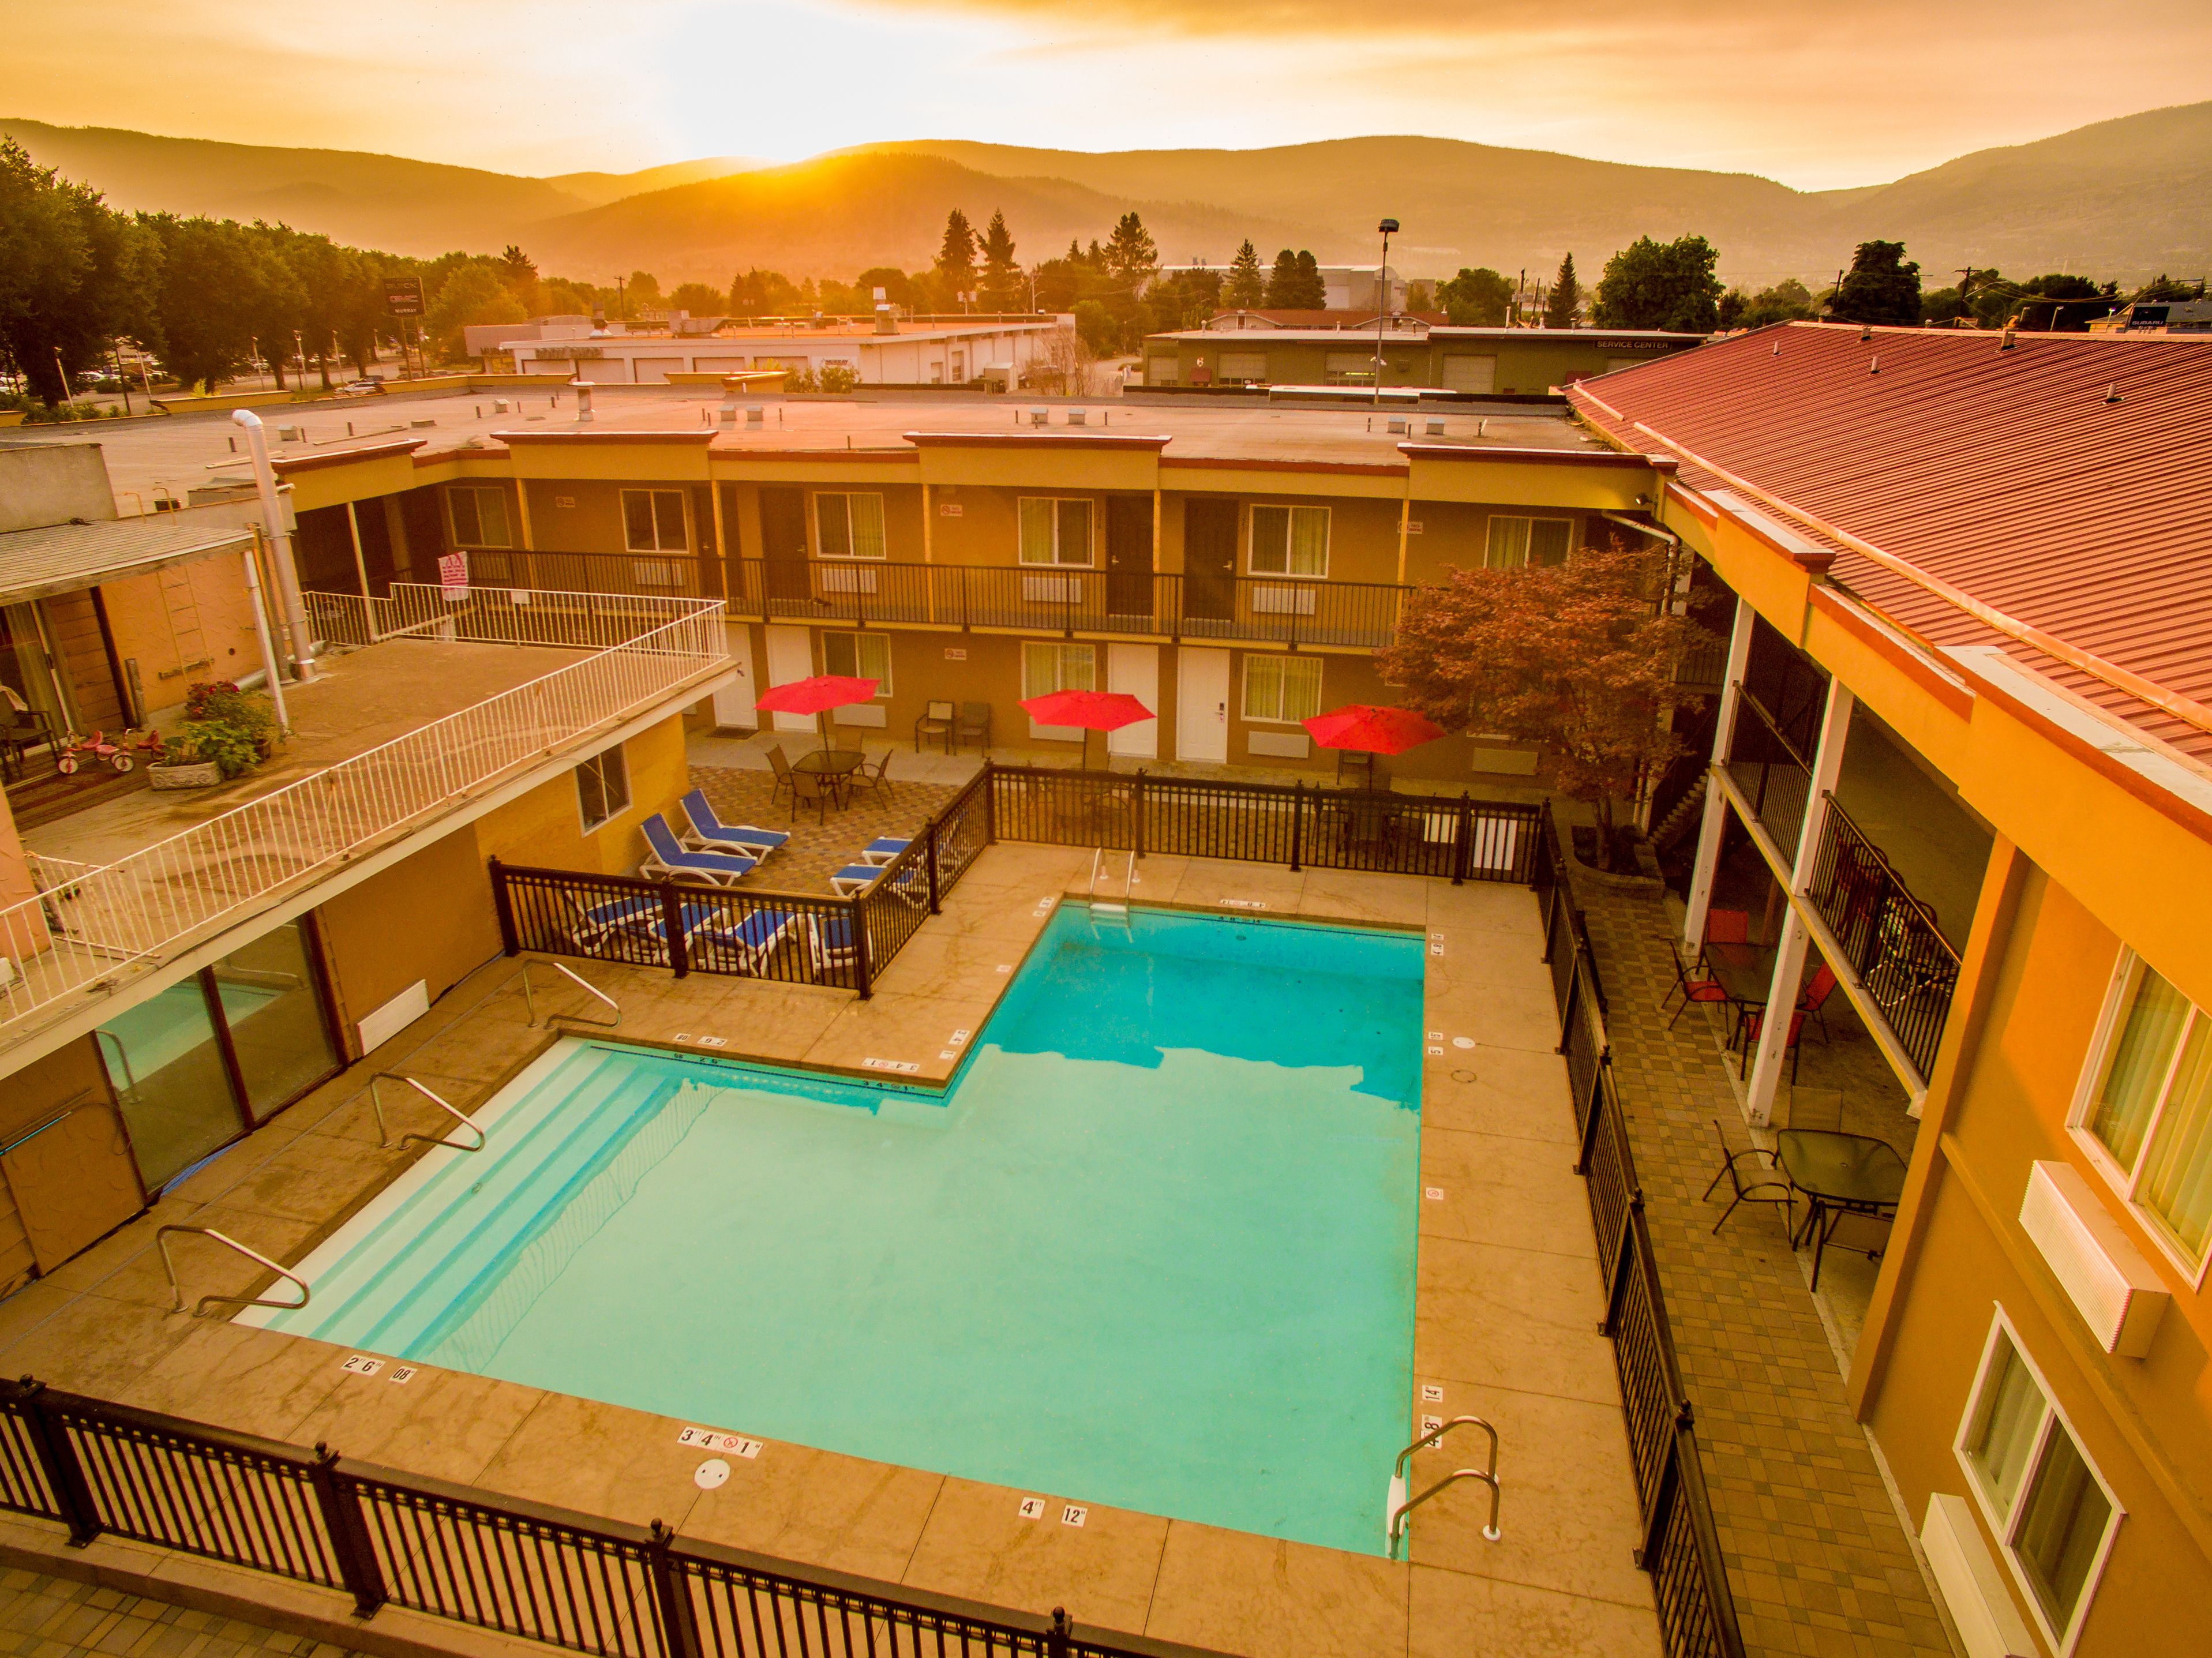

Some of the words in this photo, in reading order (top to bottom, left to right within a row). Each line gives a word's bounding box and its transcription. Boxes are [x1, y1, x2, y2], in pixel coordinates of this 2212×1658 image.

[1424, 1421, 1441, 1431] 8
[681, 1430, 694, 1441] 3
[701, 1434, 714, 1446] 4
[740, 1442, 751, 1454] 1
[1022, 1501, 1034, 1514] 4
[1064, 1507, 1081, 1523] 12
